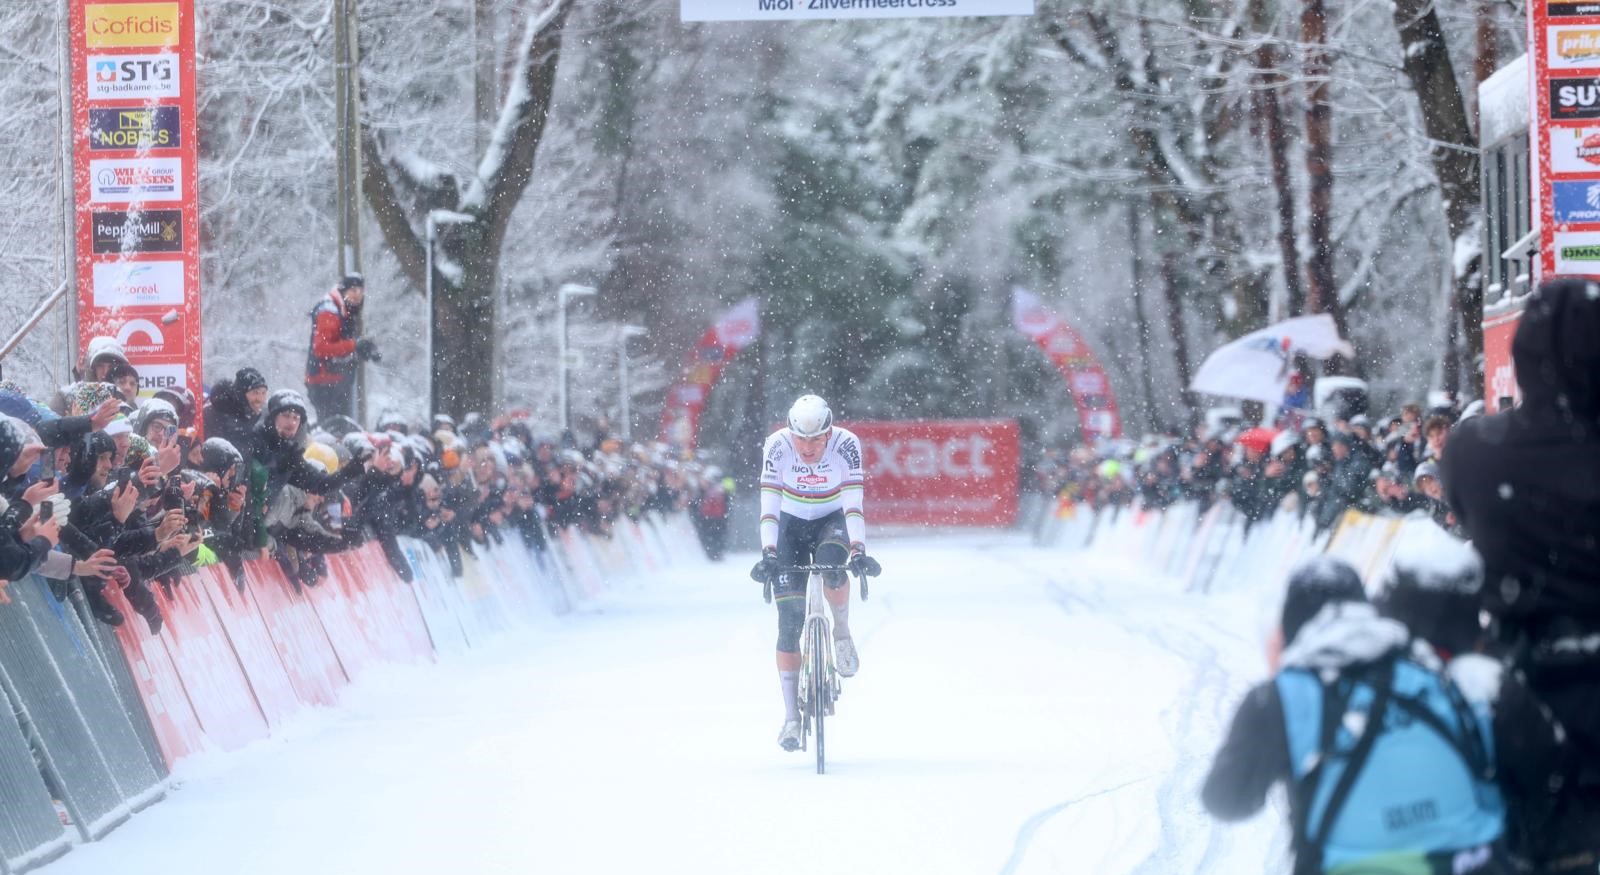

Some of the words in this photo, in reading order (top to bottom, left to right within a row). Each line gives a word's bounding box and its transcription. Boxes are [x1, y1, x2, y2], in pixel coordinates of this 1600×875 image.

[92, 16, 173, 36] Cofidis
[121, 60, 171, 82] STG
[864, 433, 993, 478] xact
